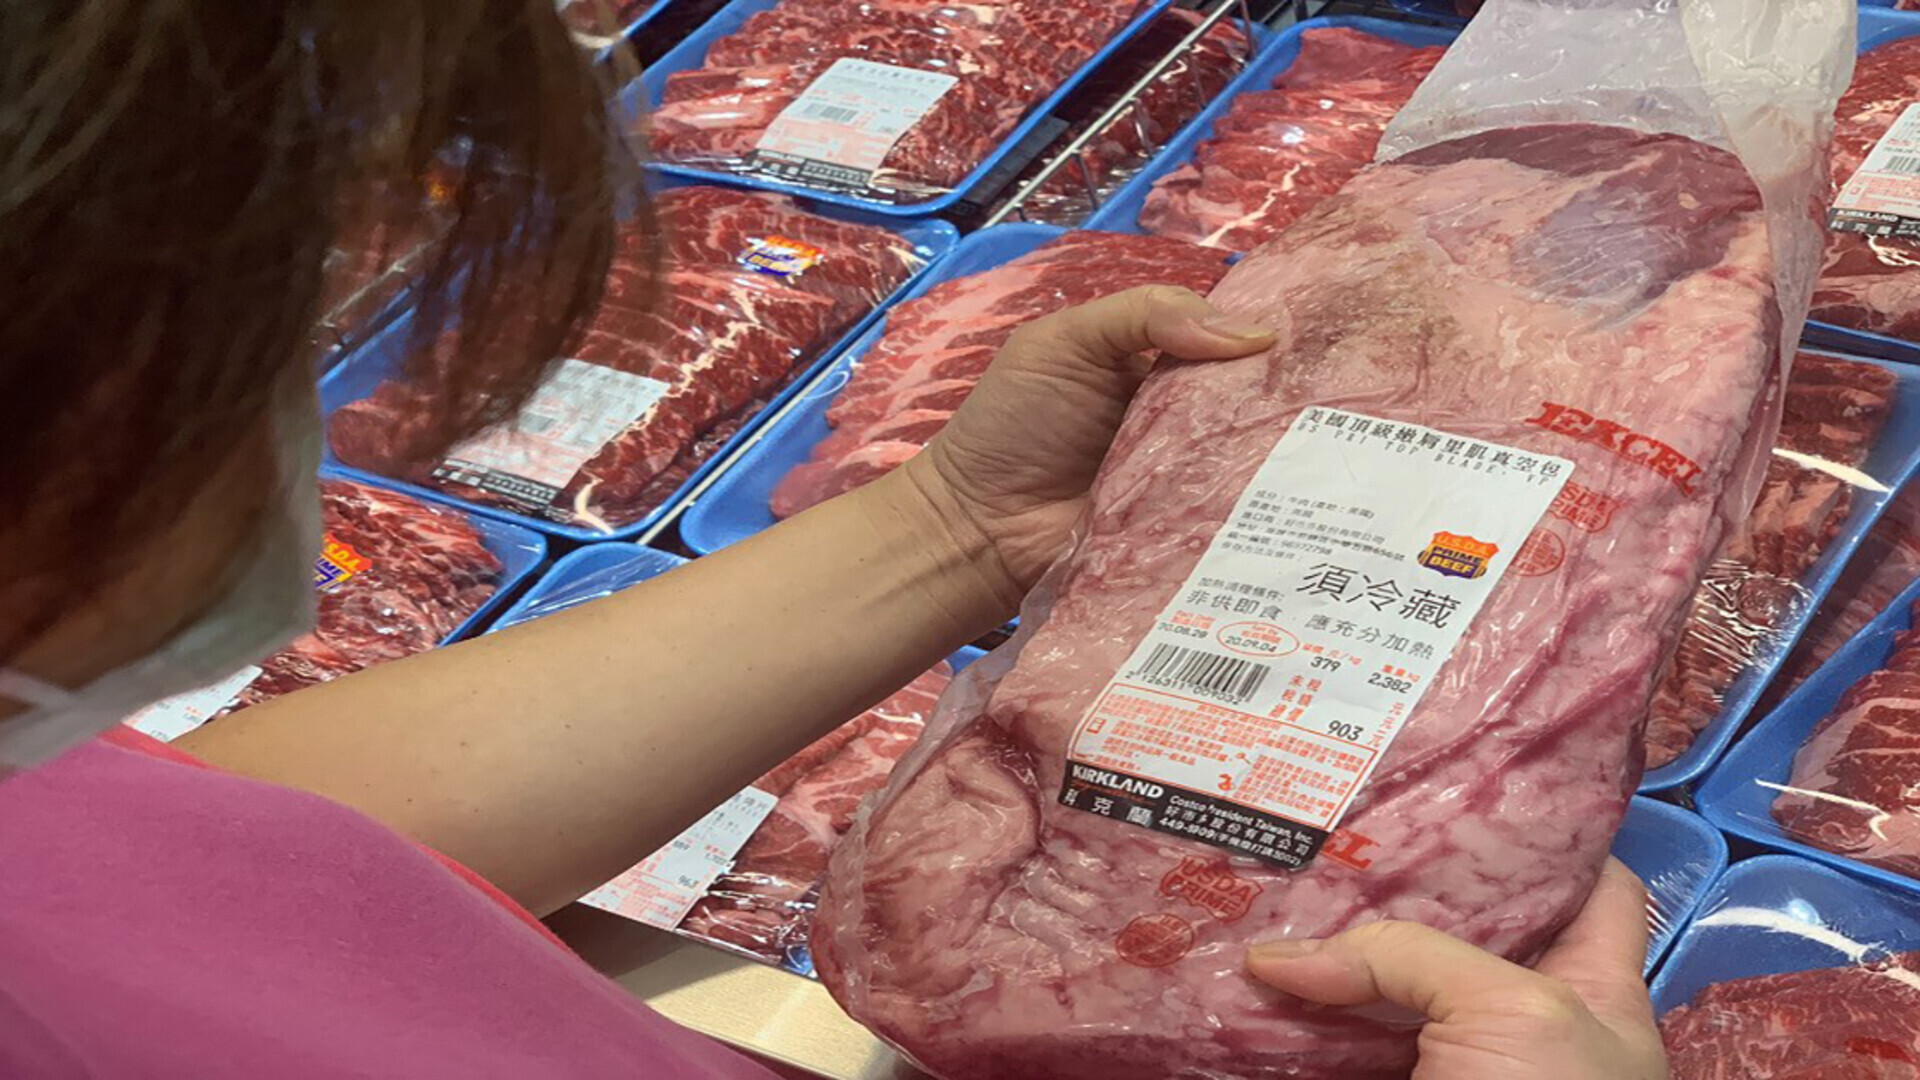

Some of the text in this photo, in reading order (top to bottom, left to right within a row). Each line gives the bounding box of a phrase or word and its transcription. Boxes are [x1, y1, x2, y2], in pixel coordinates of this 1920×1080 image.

[1306, 409, 1561, 478] 美國頂級嫩肩里肌真空包
[1333, 430, 1367, 445] PRI
[1384, 440, 1418, 456] TOP
[1524, 401, 1702, 498] EXCEL
[1562, 484, 1614, 513] SDA
[1431, 555, 1474, 573] BEEF
[1432, 545, 1484, 564] PRIME
[1296, 562, 1463, 630] 須冷藏
[1224, 635, 1278, 652] 20.09.04
[1310, 656, 1342, 672] 379
[1125, 671, 1240, 706] 2 126311 009032
[1367, 672, 1413, 694] 2.382
[1326, 719, 1364, 741] 903
[1072, 765, 1164, 798] KIRKLAND
[1063, 788, 1154, 828] 科克蘭
[1169, 795, 1207, 812] Costco
[1208, 804, 1254, 825] President
[1294, 831, 1314, 846] Inc.
[1164, 805, 1311, 856] 好市多股份有限公司
[1167, 874, 1240, 915] PRIME
[1182, 858, 1252, 902] USDA
